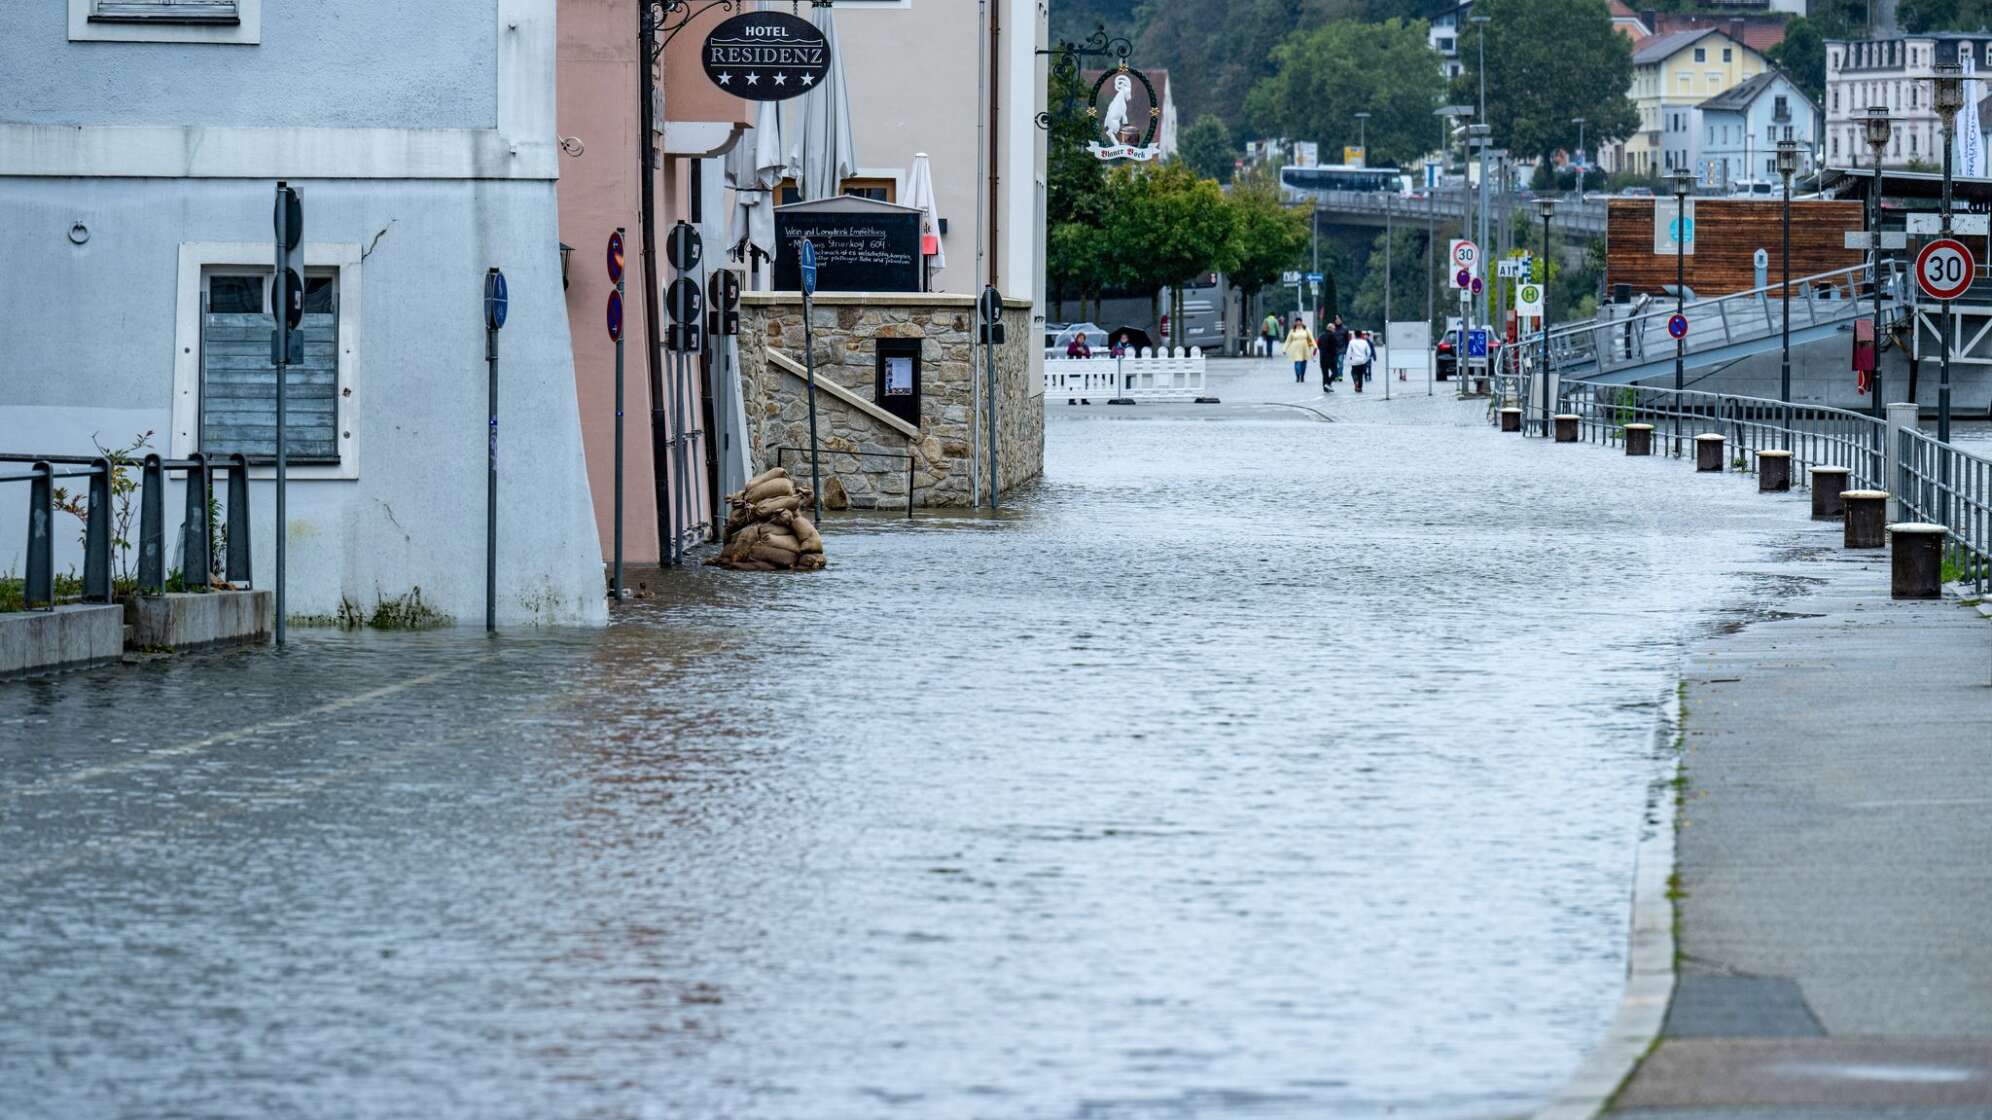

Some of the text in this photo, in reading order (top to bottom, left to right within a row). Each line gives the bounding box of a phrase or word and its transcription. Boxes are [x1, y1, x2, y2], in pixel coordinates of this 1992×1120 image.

[746, 26, 789, 37] HOTEL
[711, 48, 823, 64] RESIDENZ
[1458, 248, 1474, 261] 30
[1929, 256, 1962, 282] 30
